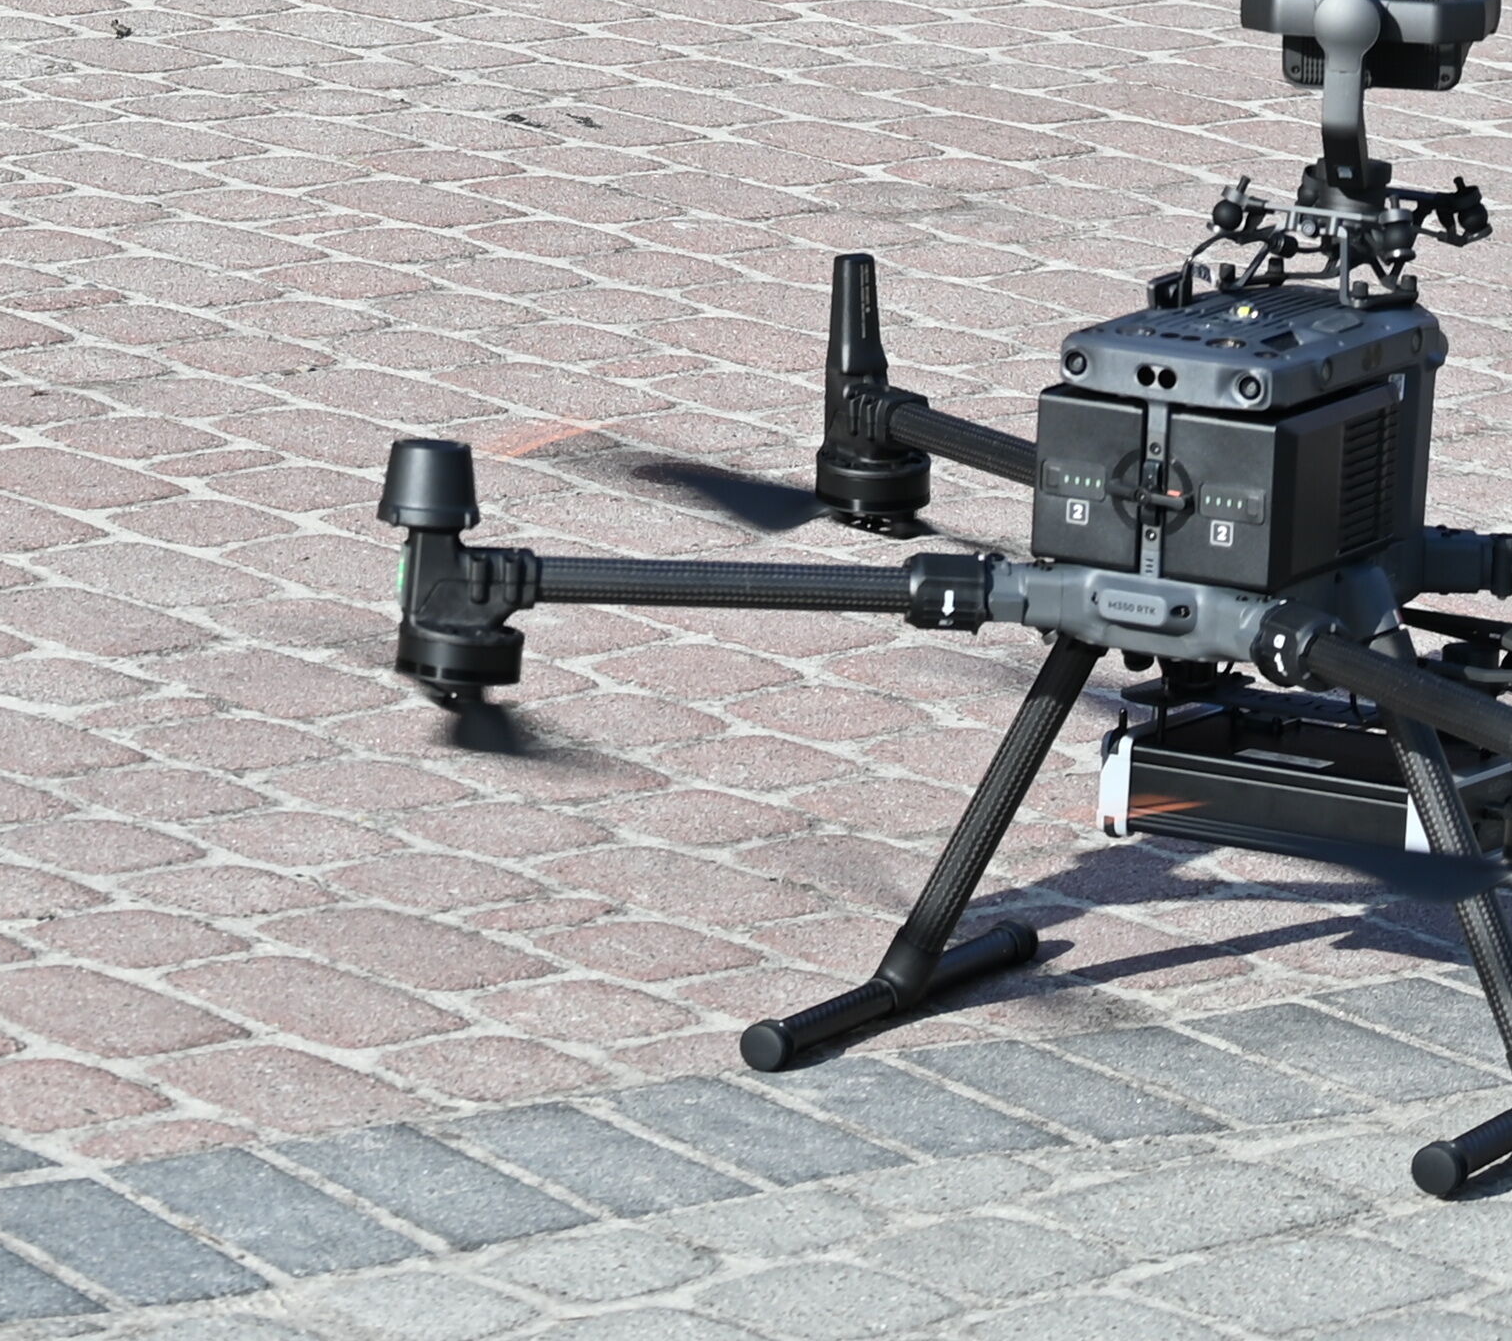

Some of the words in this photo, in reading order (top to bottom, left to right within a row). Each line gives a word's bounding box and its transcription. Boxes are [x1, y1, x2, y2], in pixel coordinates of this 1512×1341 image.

[1072, 503, 1084, 520] 2
[1216, 525, 1228, 542] 2
[1136, 604, 1157, 616] RTK
